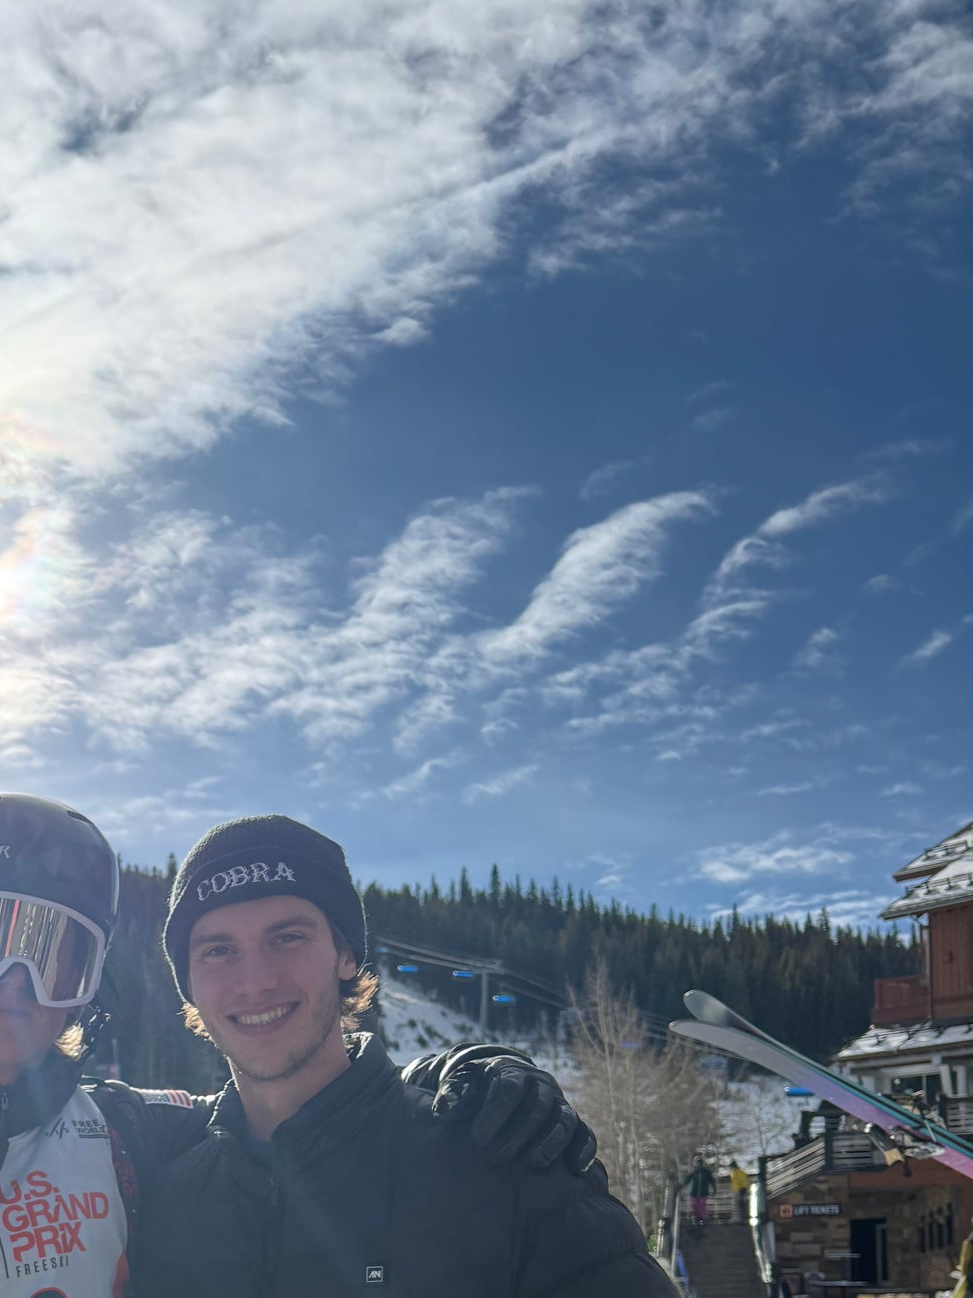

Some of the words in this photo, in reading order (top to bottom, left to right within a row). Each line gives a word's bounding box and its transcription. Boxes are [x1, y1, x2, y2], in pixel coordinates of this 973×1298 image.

[197, 862, 296, 901] COBRA
[2, 1192, 109, 1232] GRAND
[10, 1221, 87, 1262] PRIX
[16, 1255, 69, 1277] FREESKI
